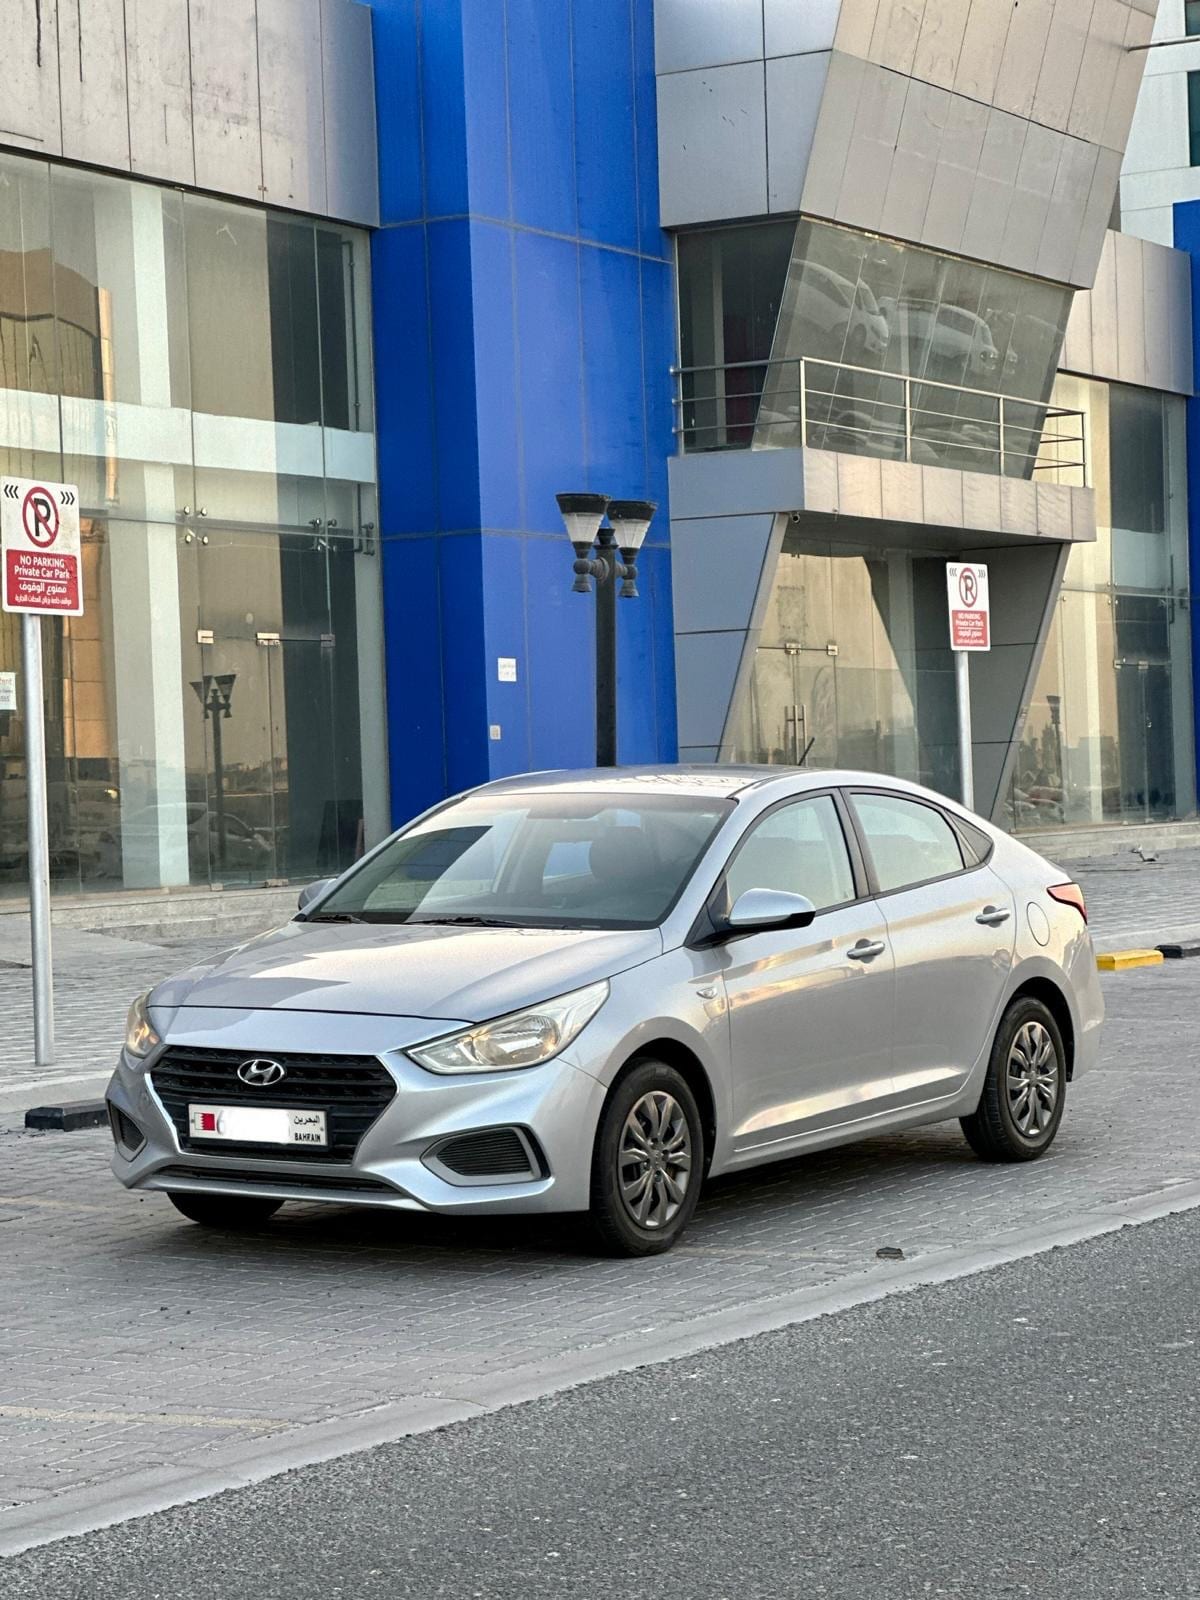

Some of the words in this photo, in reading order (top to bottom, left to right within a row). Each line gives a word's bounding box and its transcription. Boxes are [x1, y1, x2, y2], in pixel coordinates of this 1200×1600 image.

[20, 555, 31, 565] NO
[33, 557, 65, 569] PARKING
[14, 565, 40, 577] Private
[41, 568, 53, 577] Car
[54, 568, 70, 579] Park
[19, 581, 45, 594] الوقوف
[46, 585, 67, 596] ممنوع
[294, 1115, 320, 1126] البحرين
[294, 1132, 321, 1142] BAHRAIN
